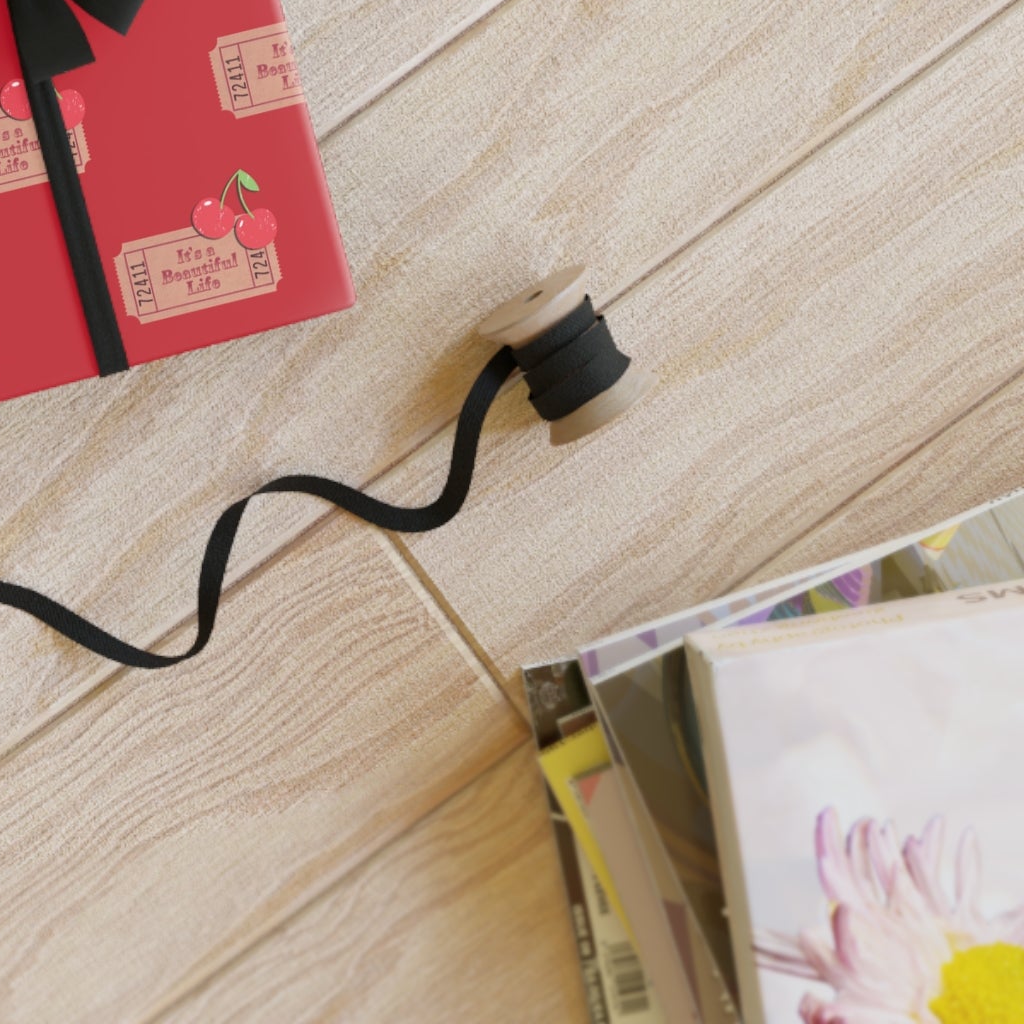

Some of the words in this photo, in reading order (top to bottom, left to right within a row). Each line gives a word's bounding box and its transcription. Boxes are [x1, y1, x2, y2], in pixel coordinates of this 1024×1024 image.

[225, 55, 248, 101] 72411
[14, 128, 24, 138] a
[161, 252, 239, 285] Beautiful
[176, 247, 202, 264] It's
[206, 247, 215, 257] a
[250, 250, 270, 279] 724
[130, 261, 153, 307] 72411
[186, 276, 221, 296] Life
